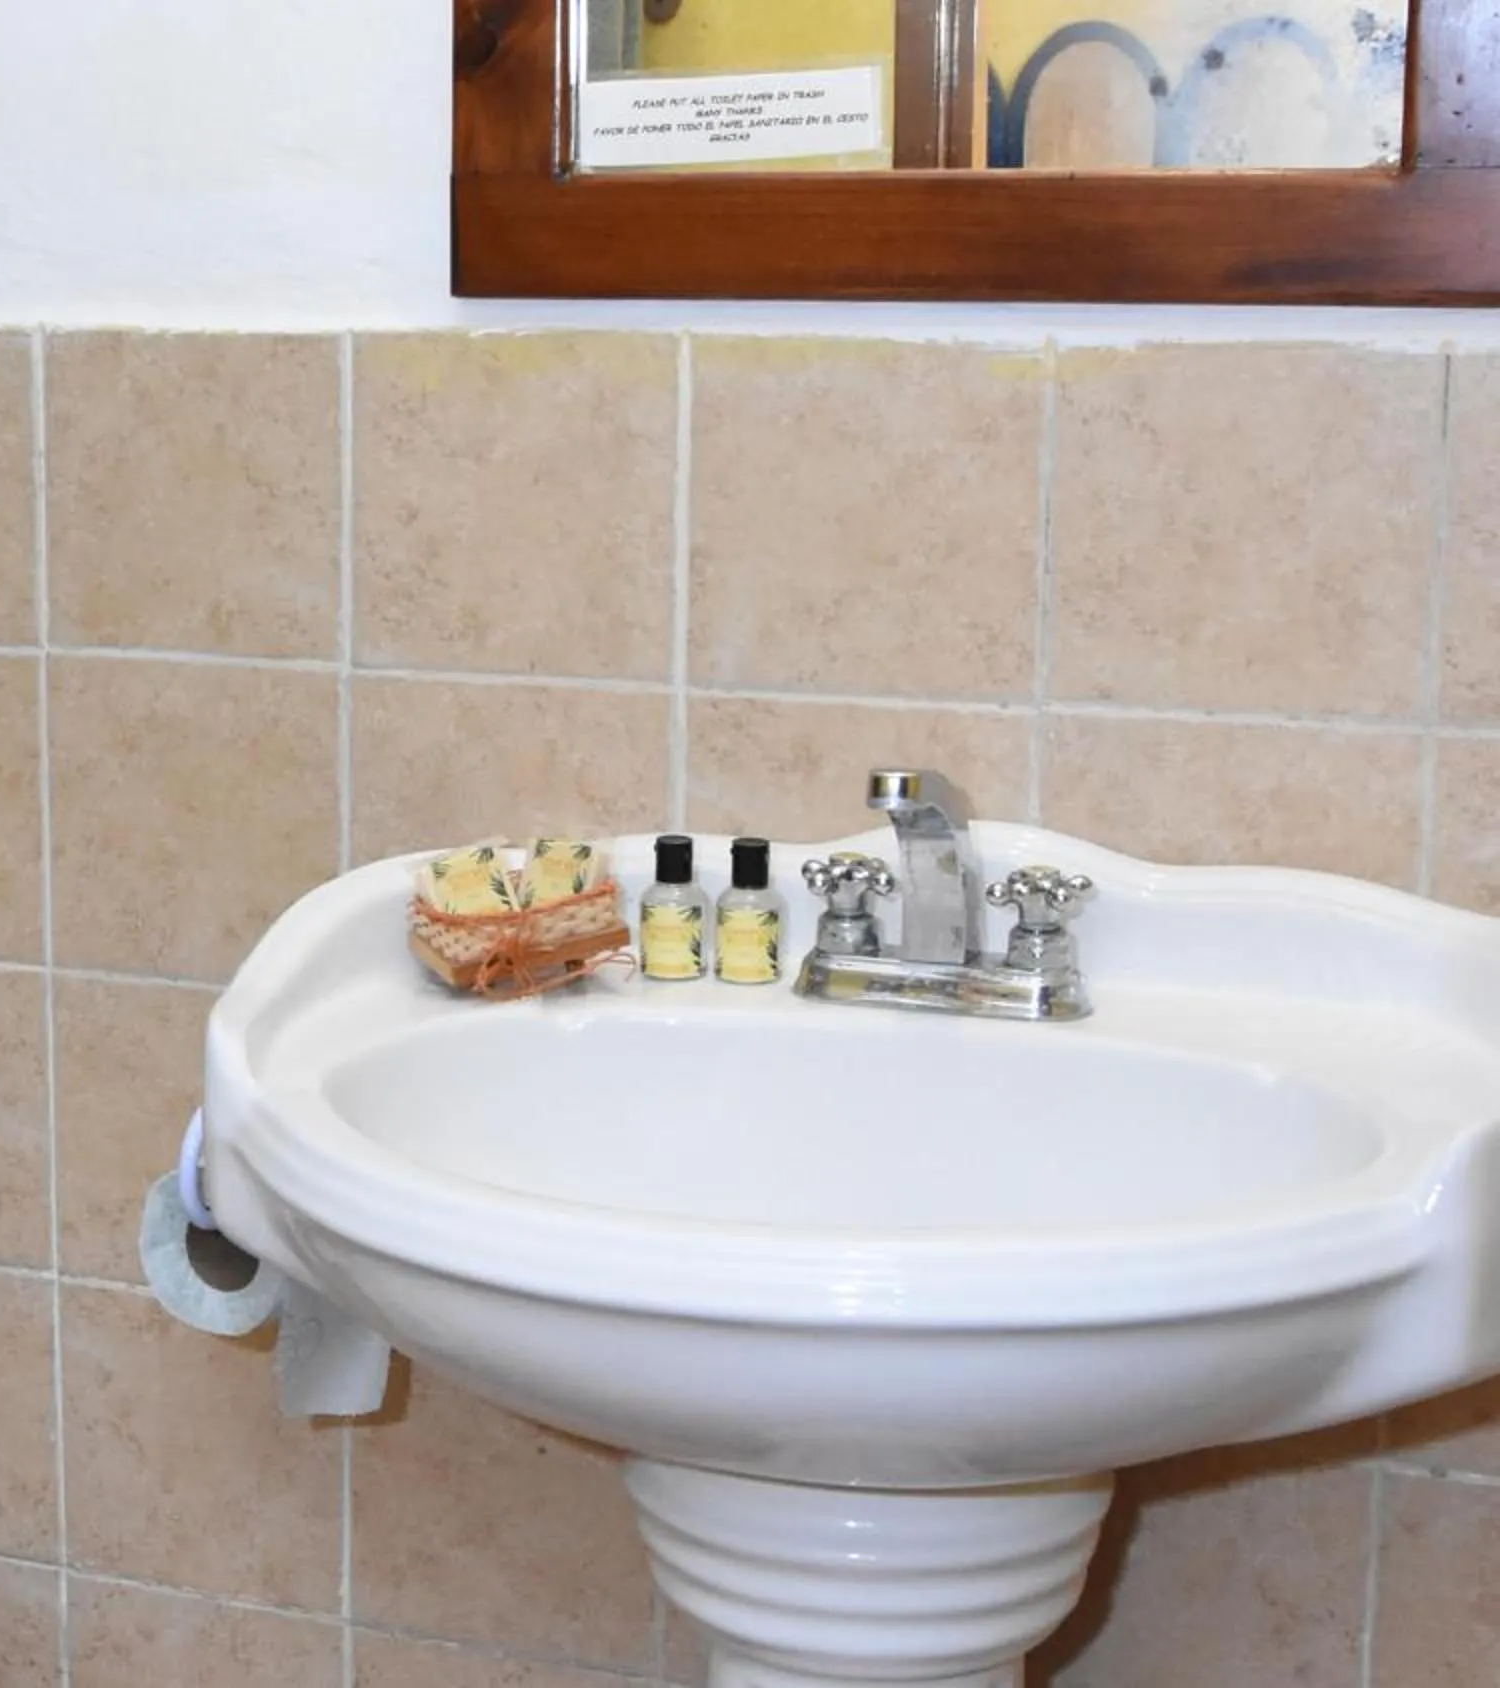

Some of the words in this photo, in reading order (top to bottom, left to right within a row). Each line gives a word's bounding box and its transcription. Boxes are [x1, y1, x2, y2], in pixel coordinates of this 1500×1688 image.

[632, 98, 665, 109] PLEASE
[709, 93, 743, 104] TOILET
[746, 92, 773, 101] PAPER
[777, 91, 789, 100] IN
[793, 89, 825, 99] TRASH
[726, 106, 762, 115] THANKS
[593, 127, 624, 136] FAVOR
[627, 125, 640, 134] DE
[748, 116, 804, 128] SANITARIO
[806, 115, 820, 125] EN
[708, 131, 750, 142] GRACIAS
